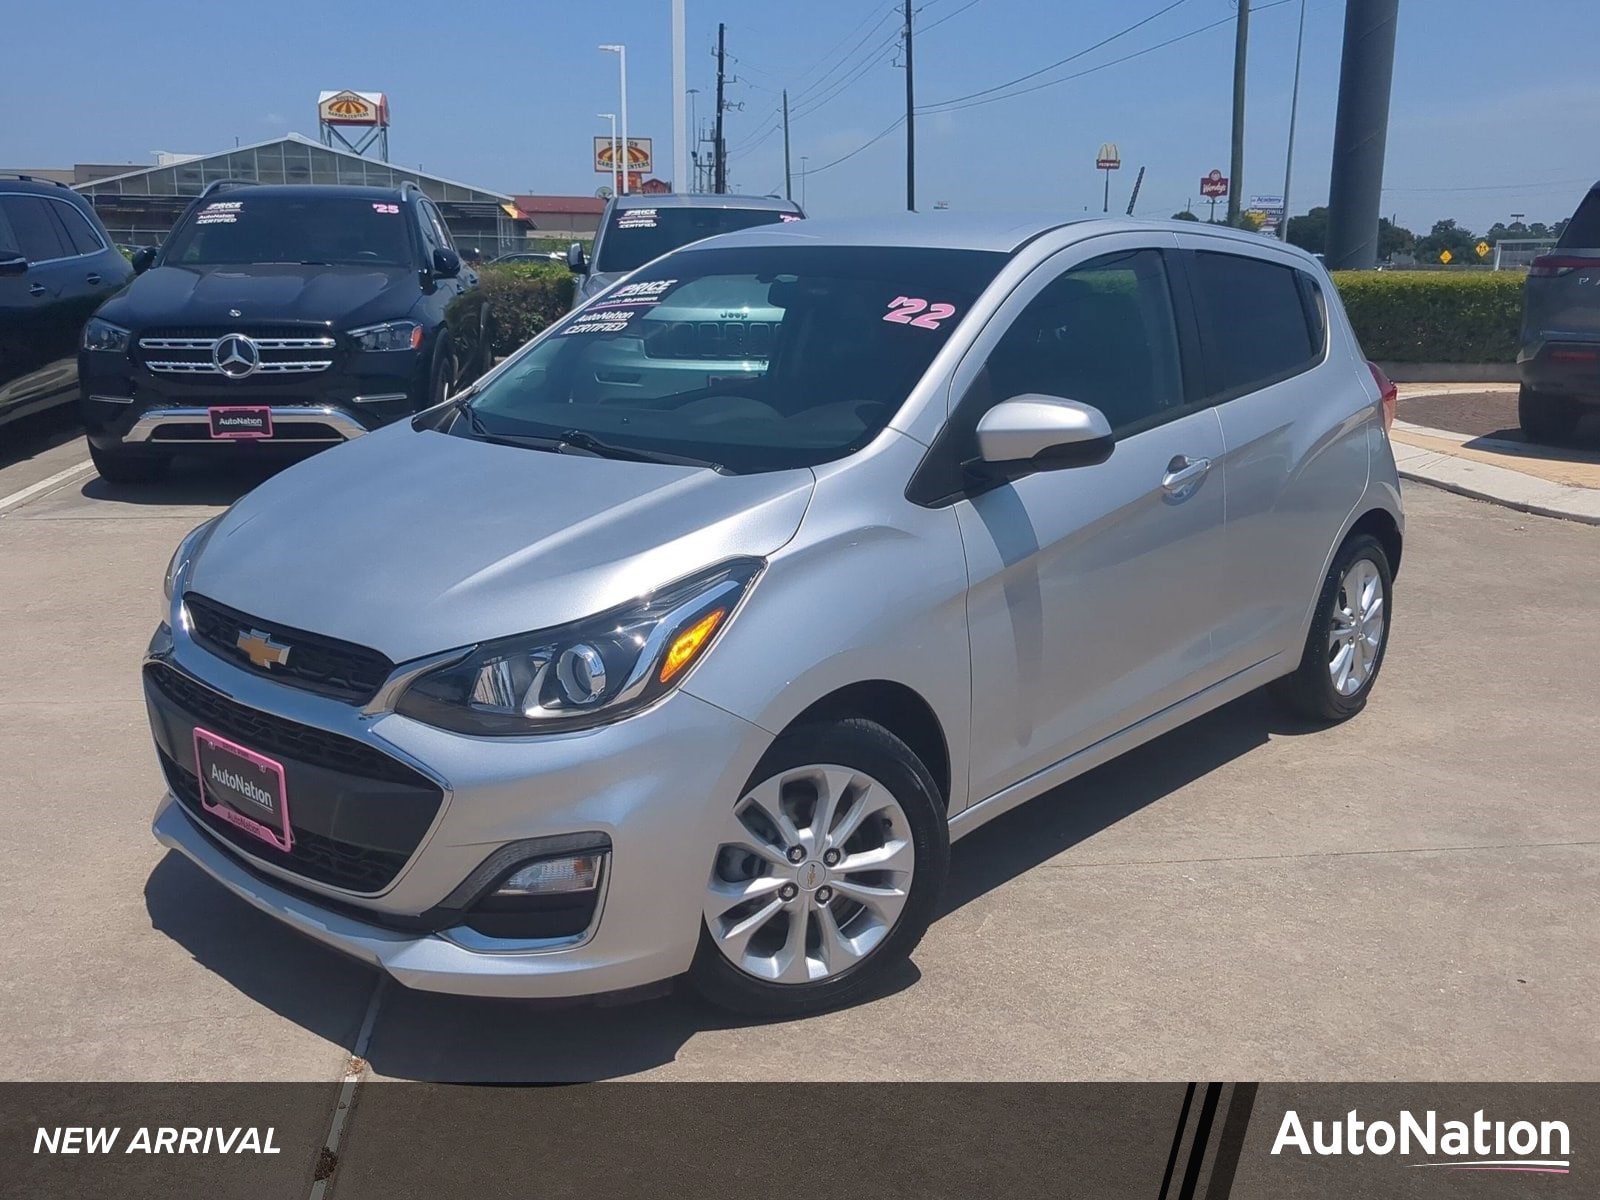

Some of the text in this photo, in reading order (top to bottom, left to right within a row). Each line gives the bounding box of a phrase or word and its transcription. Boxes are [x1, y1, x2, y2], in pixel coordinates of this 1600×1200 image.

[623, 161, 650, 170] ENTERS
[573, 311, 635, 324] AutoNation
[720, 312, 748, 320] Jeep
[883, 296, 956, 330] '22
[560, 322, 628, 335] CERTIFIED
[220, 416, 263, 425] AutoNation
[211, 763, 274, 808] AutoNation
